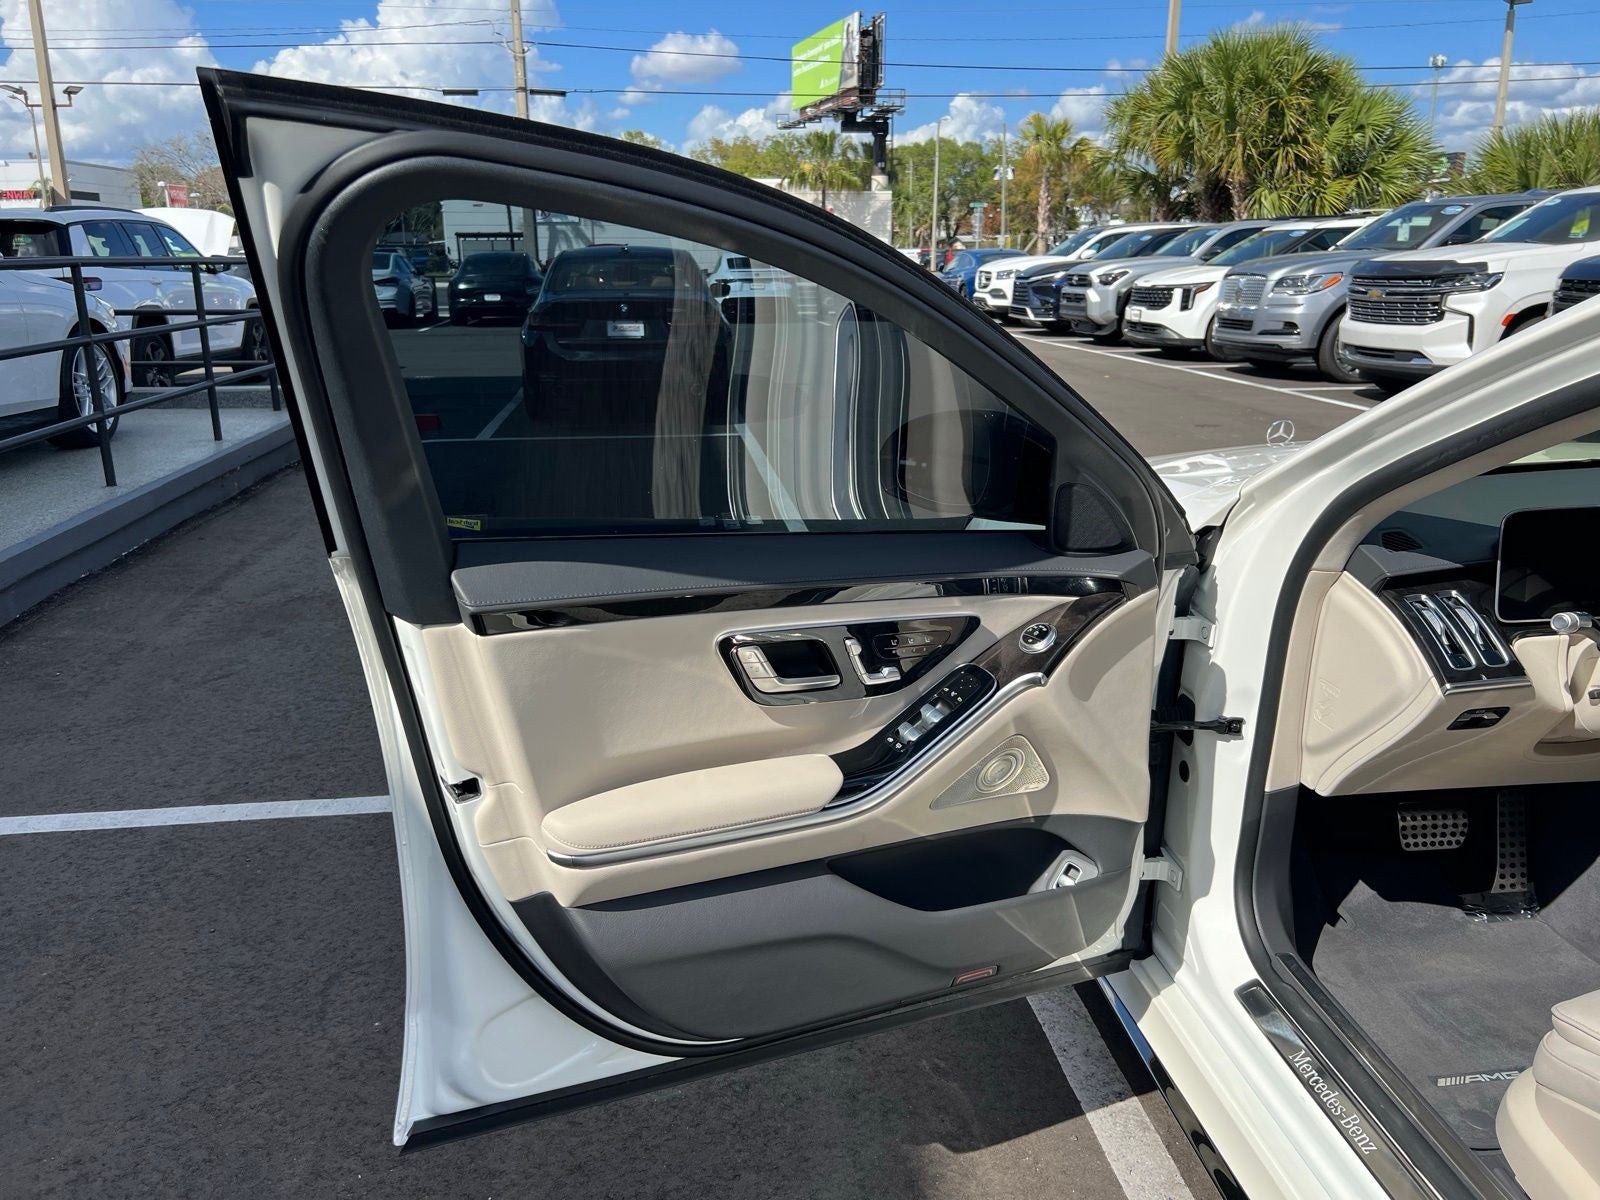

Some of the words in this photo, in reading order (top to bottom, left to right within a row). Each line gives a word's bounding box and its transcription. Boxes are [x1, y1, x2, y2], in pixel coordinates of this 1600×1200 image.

[0, 190, 35, 199] ENWAY
[1464, 1070, 1520, 1084] AMG
[1288, 1048, 1378, 1155] Mercedes-Benz
